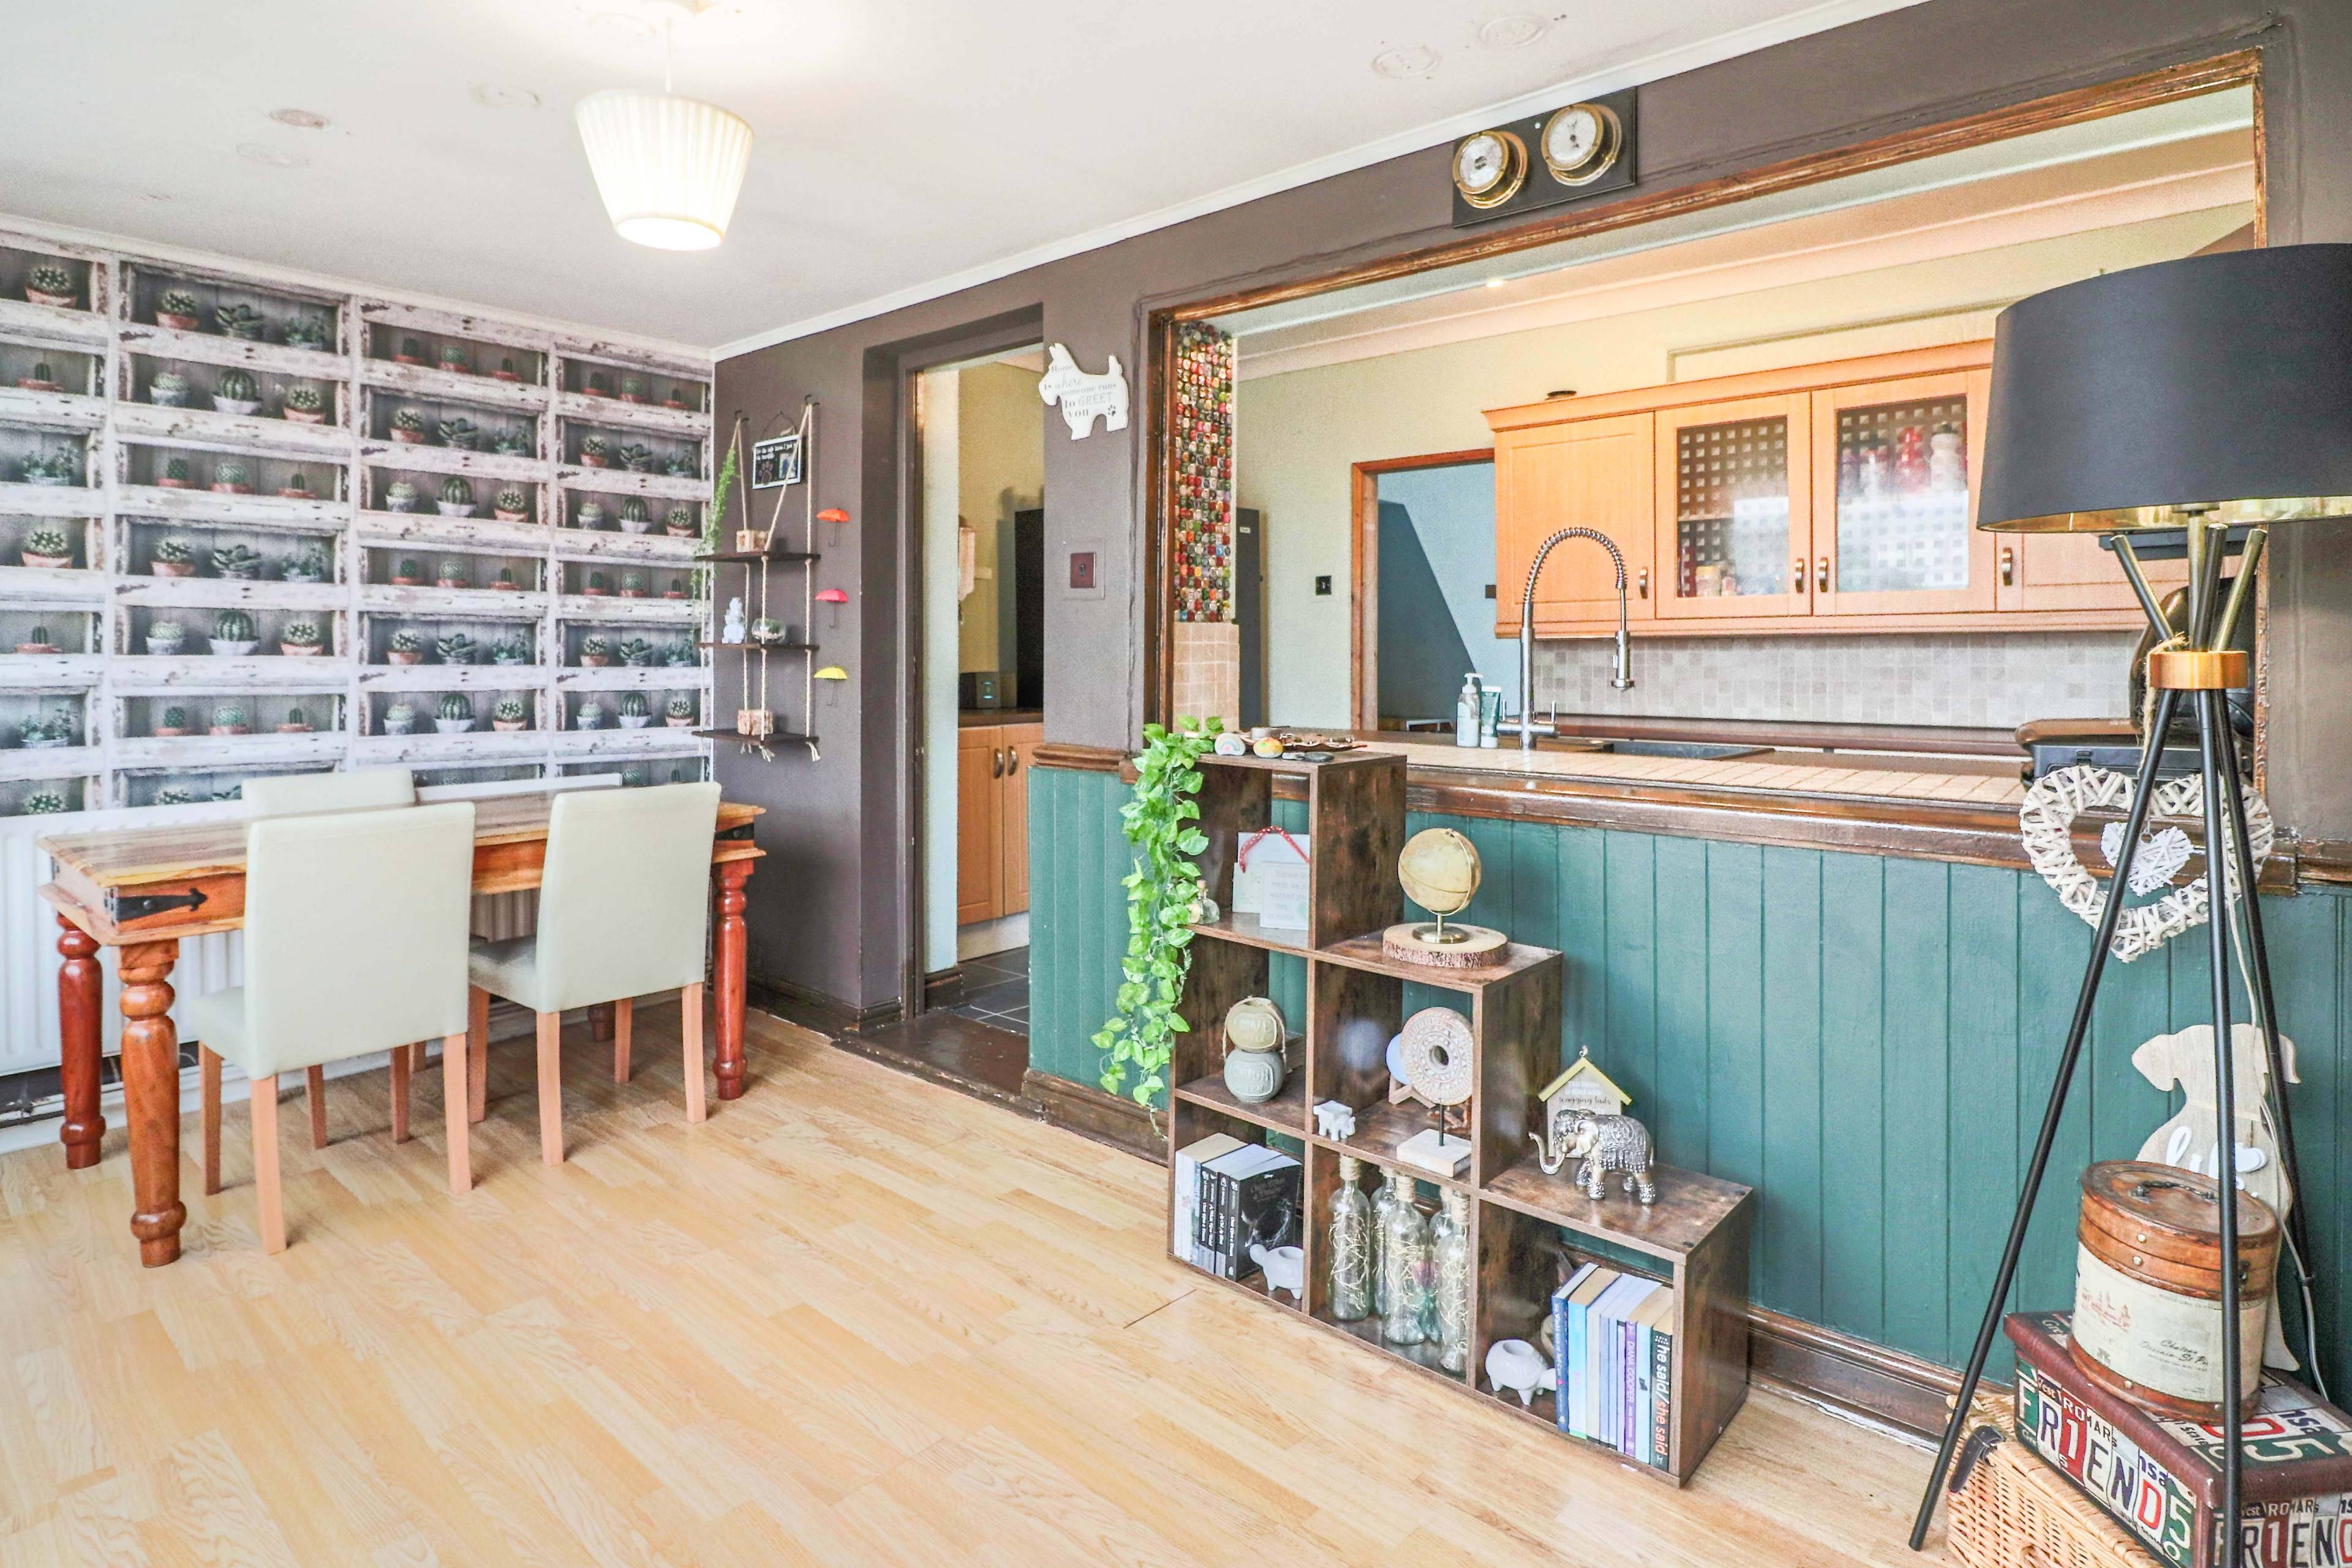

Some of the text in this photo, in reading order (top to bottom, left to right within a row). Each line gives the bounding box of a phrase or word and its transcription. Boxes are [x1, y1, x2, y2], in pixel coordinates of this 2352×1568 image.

[1079, 392, 1113, 406] GREET
[1559, 1096, 1593, 1105] wagging
[1626, 1341, 1635, 1366] DIANA
[1657, 1344, 1670, 1362] he
[1626, 1367, 1635, 1403] COOPER
[1656, 1427, 1668, 1455] said
